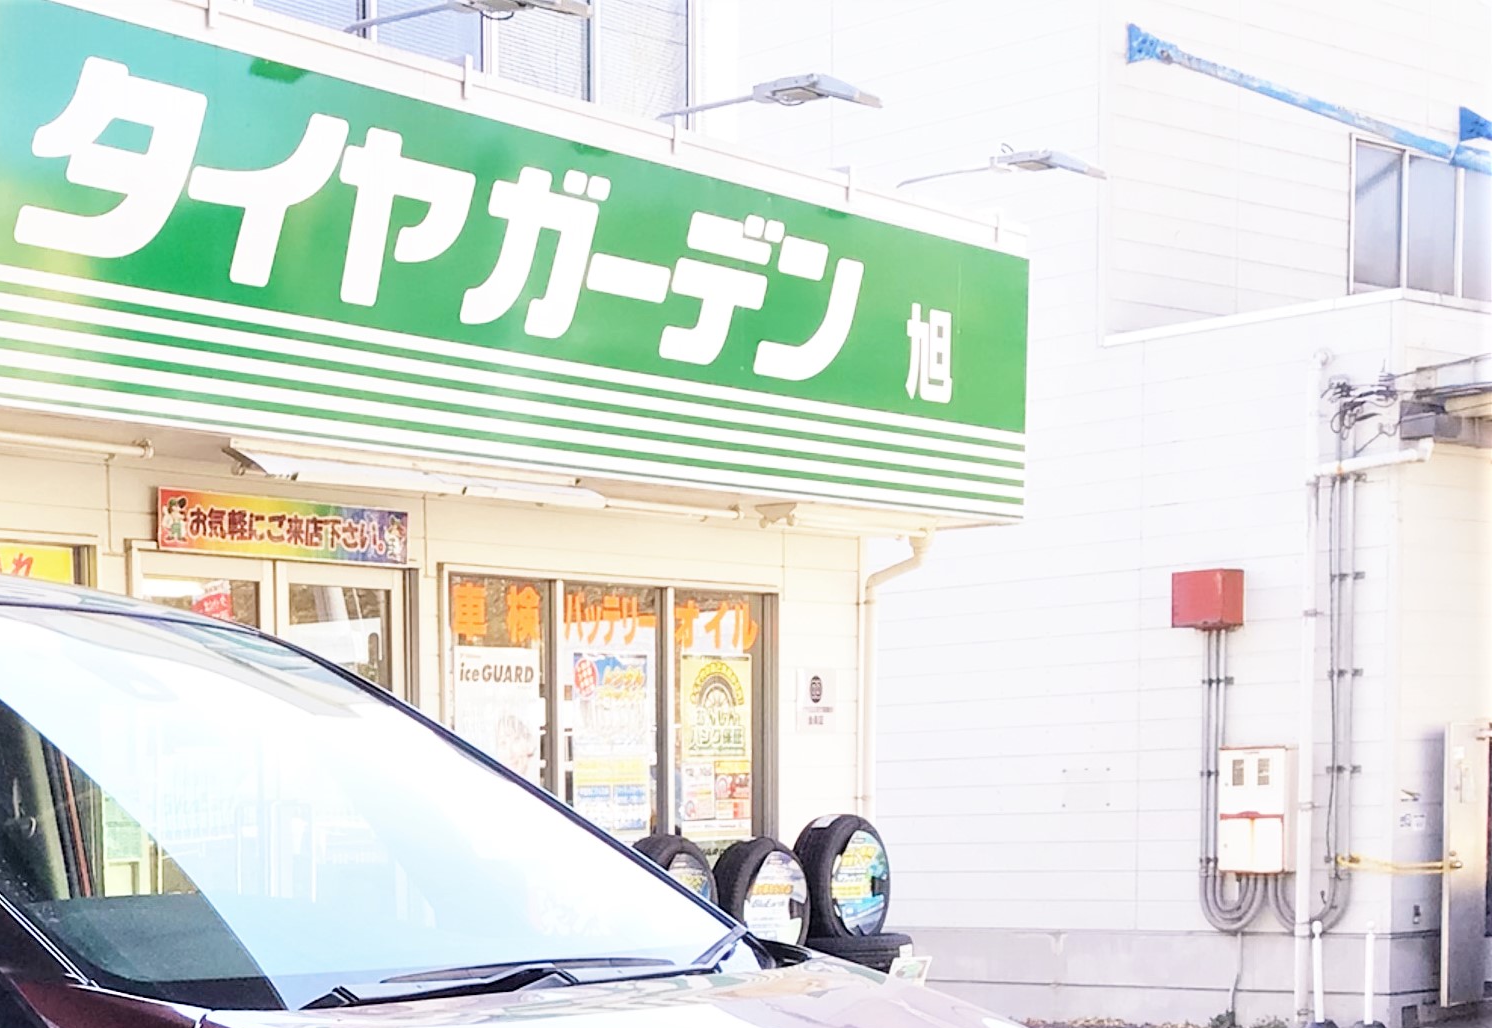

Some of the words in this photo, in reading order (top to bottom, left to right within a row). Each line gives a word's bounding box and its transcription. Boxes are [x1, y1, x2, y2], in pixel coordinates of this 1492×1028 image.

[14, 56, 864, 381] タイヤガーデン
[905, 302, 953, 404] 旭
[189, 506, 386, 554] お気軽にご来店下さい。
[564, 591, 656, 645] バッテリー
[674, 599, 758, 650] オイル
